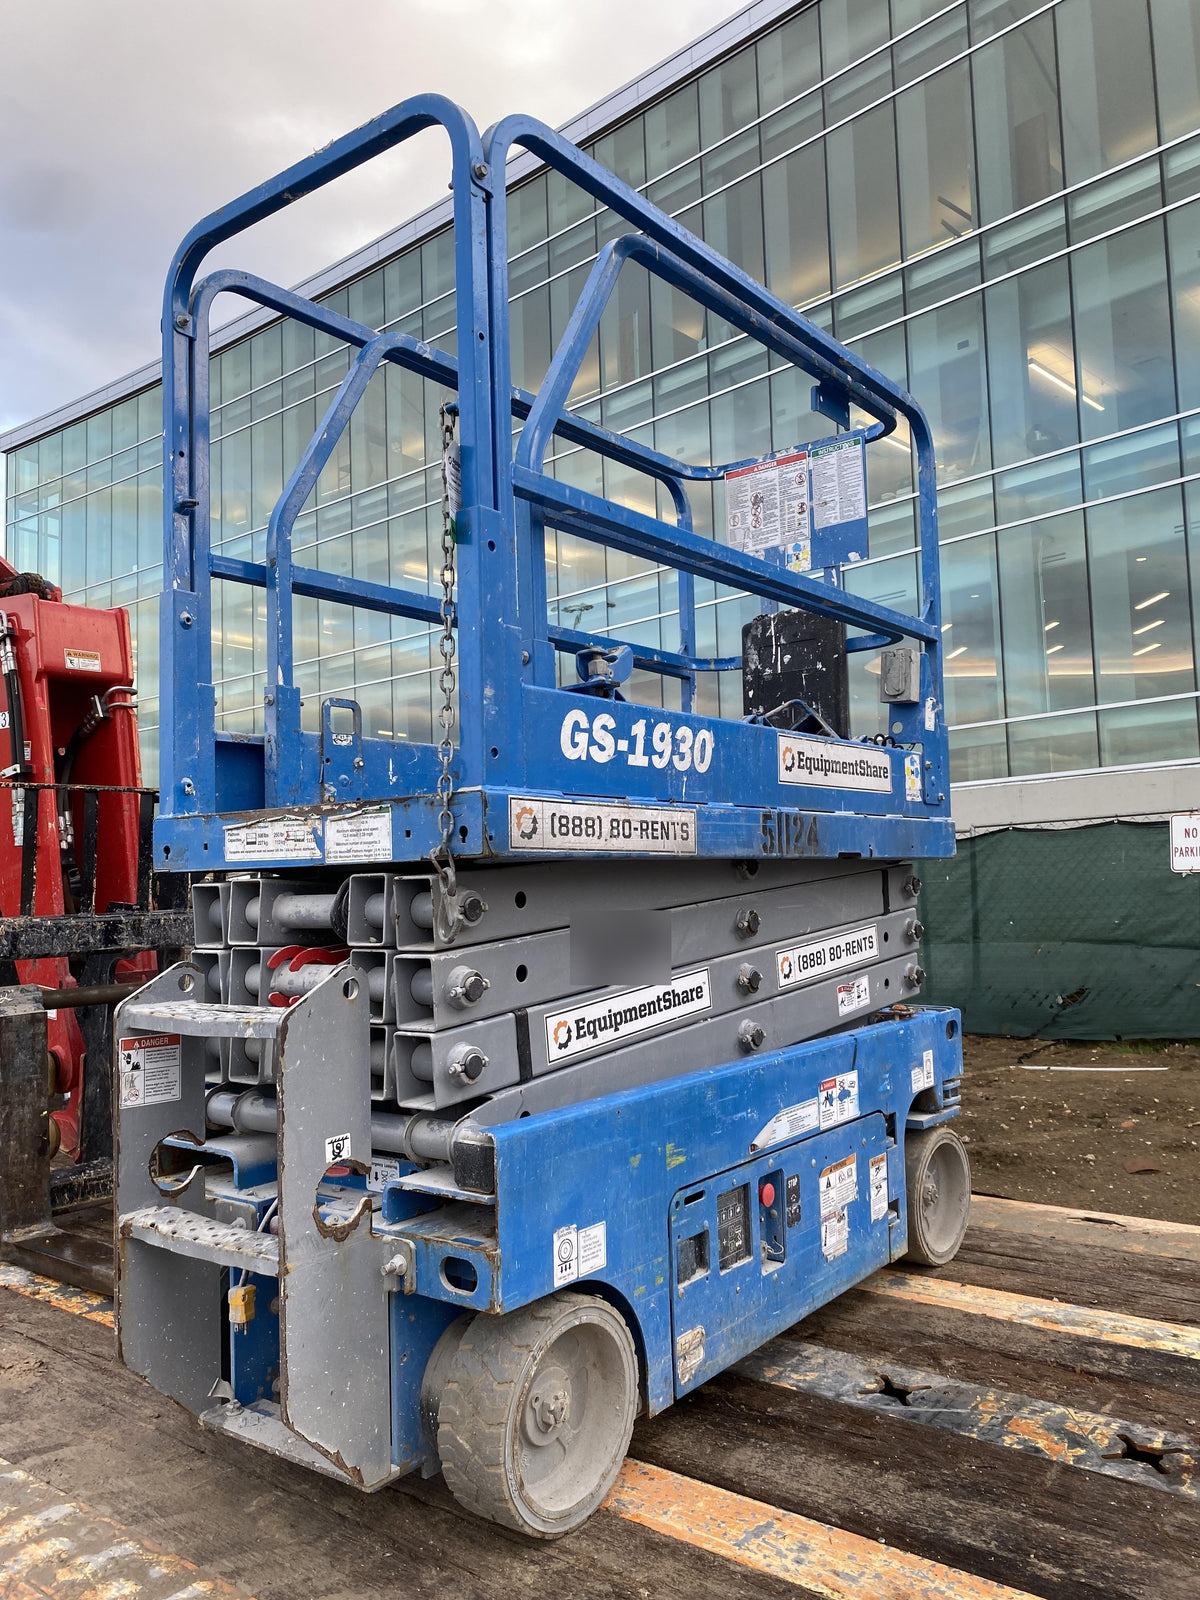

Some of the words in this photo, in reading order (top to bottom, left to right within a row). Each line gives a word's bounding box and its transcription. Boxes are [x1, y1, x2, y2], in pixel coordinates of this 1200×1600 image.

[560, 709, 714, 773] GS-1930
[797, 751, 888, 779] EquipmentShare
[550, 812, 602, 839] (888)
[609, 818, 690, 841] 80-RENTS
[760, 811, 819, 855] 51124
[1184, 827, 1198, 838] NO
[1174, 846, 1200, 857] PARKI
[797, 952, 828, 973] (888)
[829, 935, 875, 962] 80-RENTS
[575, 984, 704, 1041] EquipmentShare
[141, 1037, 169, 1047] DANGER
[787, 1177, 798, 1188] STOP
